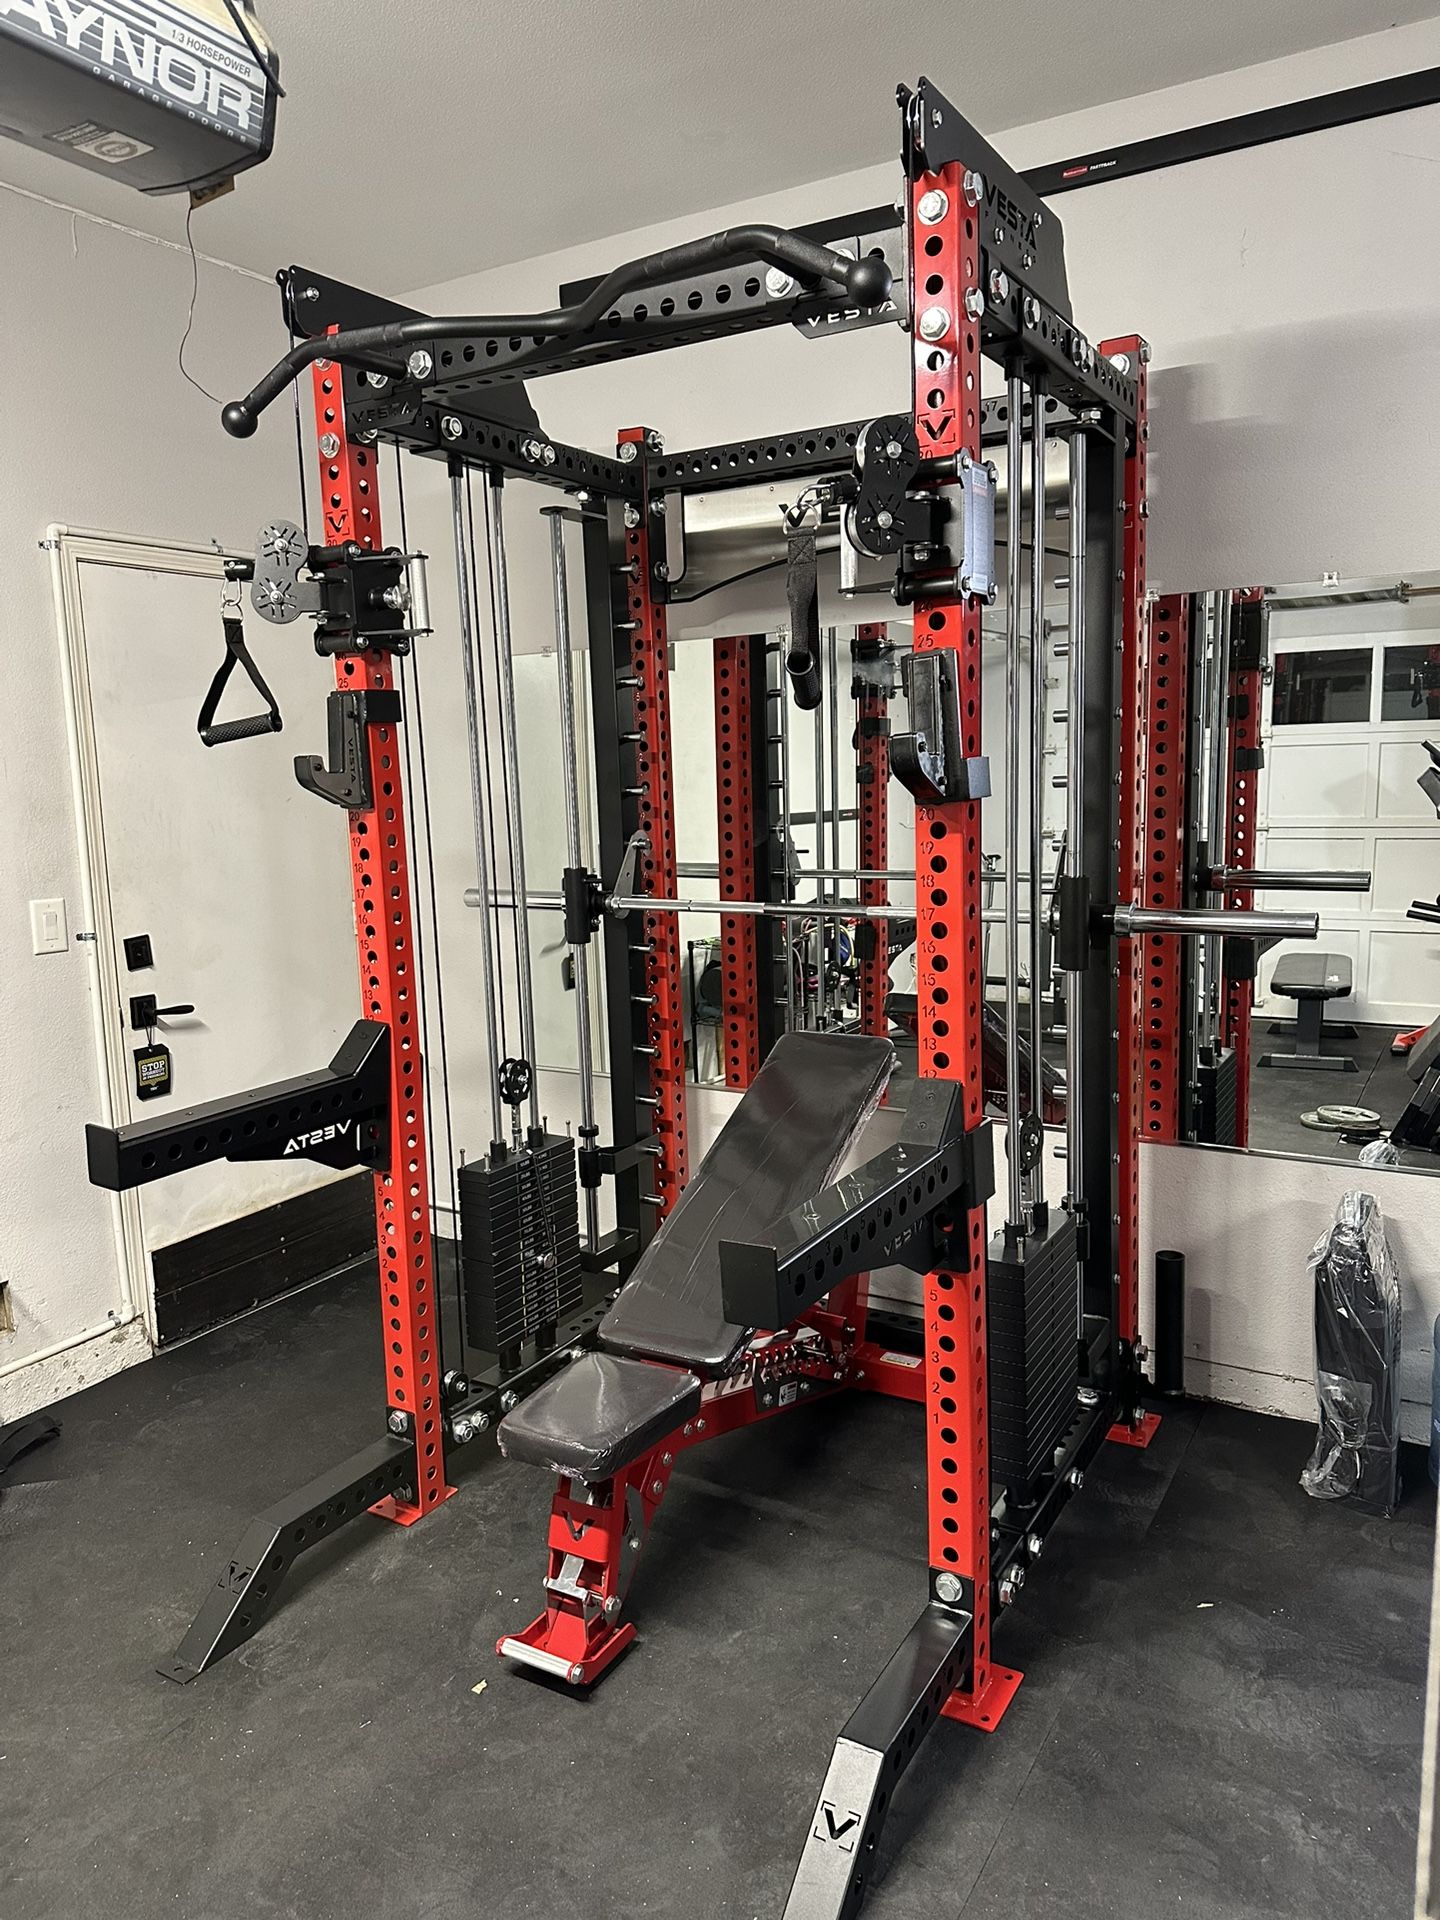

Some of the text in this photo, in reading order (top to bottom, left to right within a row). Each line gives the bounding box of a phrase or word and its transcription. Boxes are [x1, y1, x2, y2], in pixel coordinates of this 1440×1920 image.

[171, 28, 252, 78] 1/3 HORSEPOWER
[92, 66, 247, 143] GARAGE DOORS
[983, 174, 1037, 250] VESTA
[985, 400, 998, 412] 17
[918, 634, 934, 648] 25
[338, 677, 348, 689] 25
[347, 738, 357, 783] VESTA
[350, 811, 360, 822] 20
[919, 808, 935, 821] 20
[352, 837, 361, 847] 19
[920, 841, 933, 854] 19
[354, 863, 363, 873] 18
[921, 875, 935, 888] 18
[356, 888, 365, 899] 17
[358, 914, 367, 924] 16
[921, 908, 935, 921] 17
[360, 939, 369, 950] 15
[888, 944, 903, 955] ESTA
[921, 941, 936, 954] 16
[362, 964, 371, 975] 14
[922, 973, 936, 987] 15
[364, 989, 373, 1000] 13
[922, 1006, 937, 1018] 14
[923, 1038, 937, 1050] 13
[141, 1060, 165, 1073] STOP
[378, 1186, 384, 1197] 5
[381, 1234, 386, 1244] 3
[382, 1258, 388, 1269] 2
[930, 1290, 938, 1302] 5
[931, 1322, 939, 1333] 4
[931, 1351, 939, 1363] 3
[932, 1382, 940, 1394] 2
[933, 1413, 939, 1424] 1
